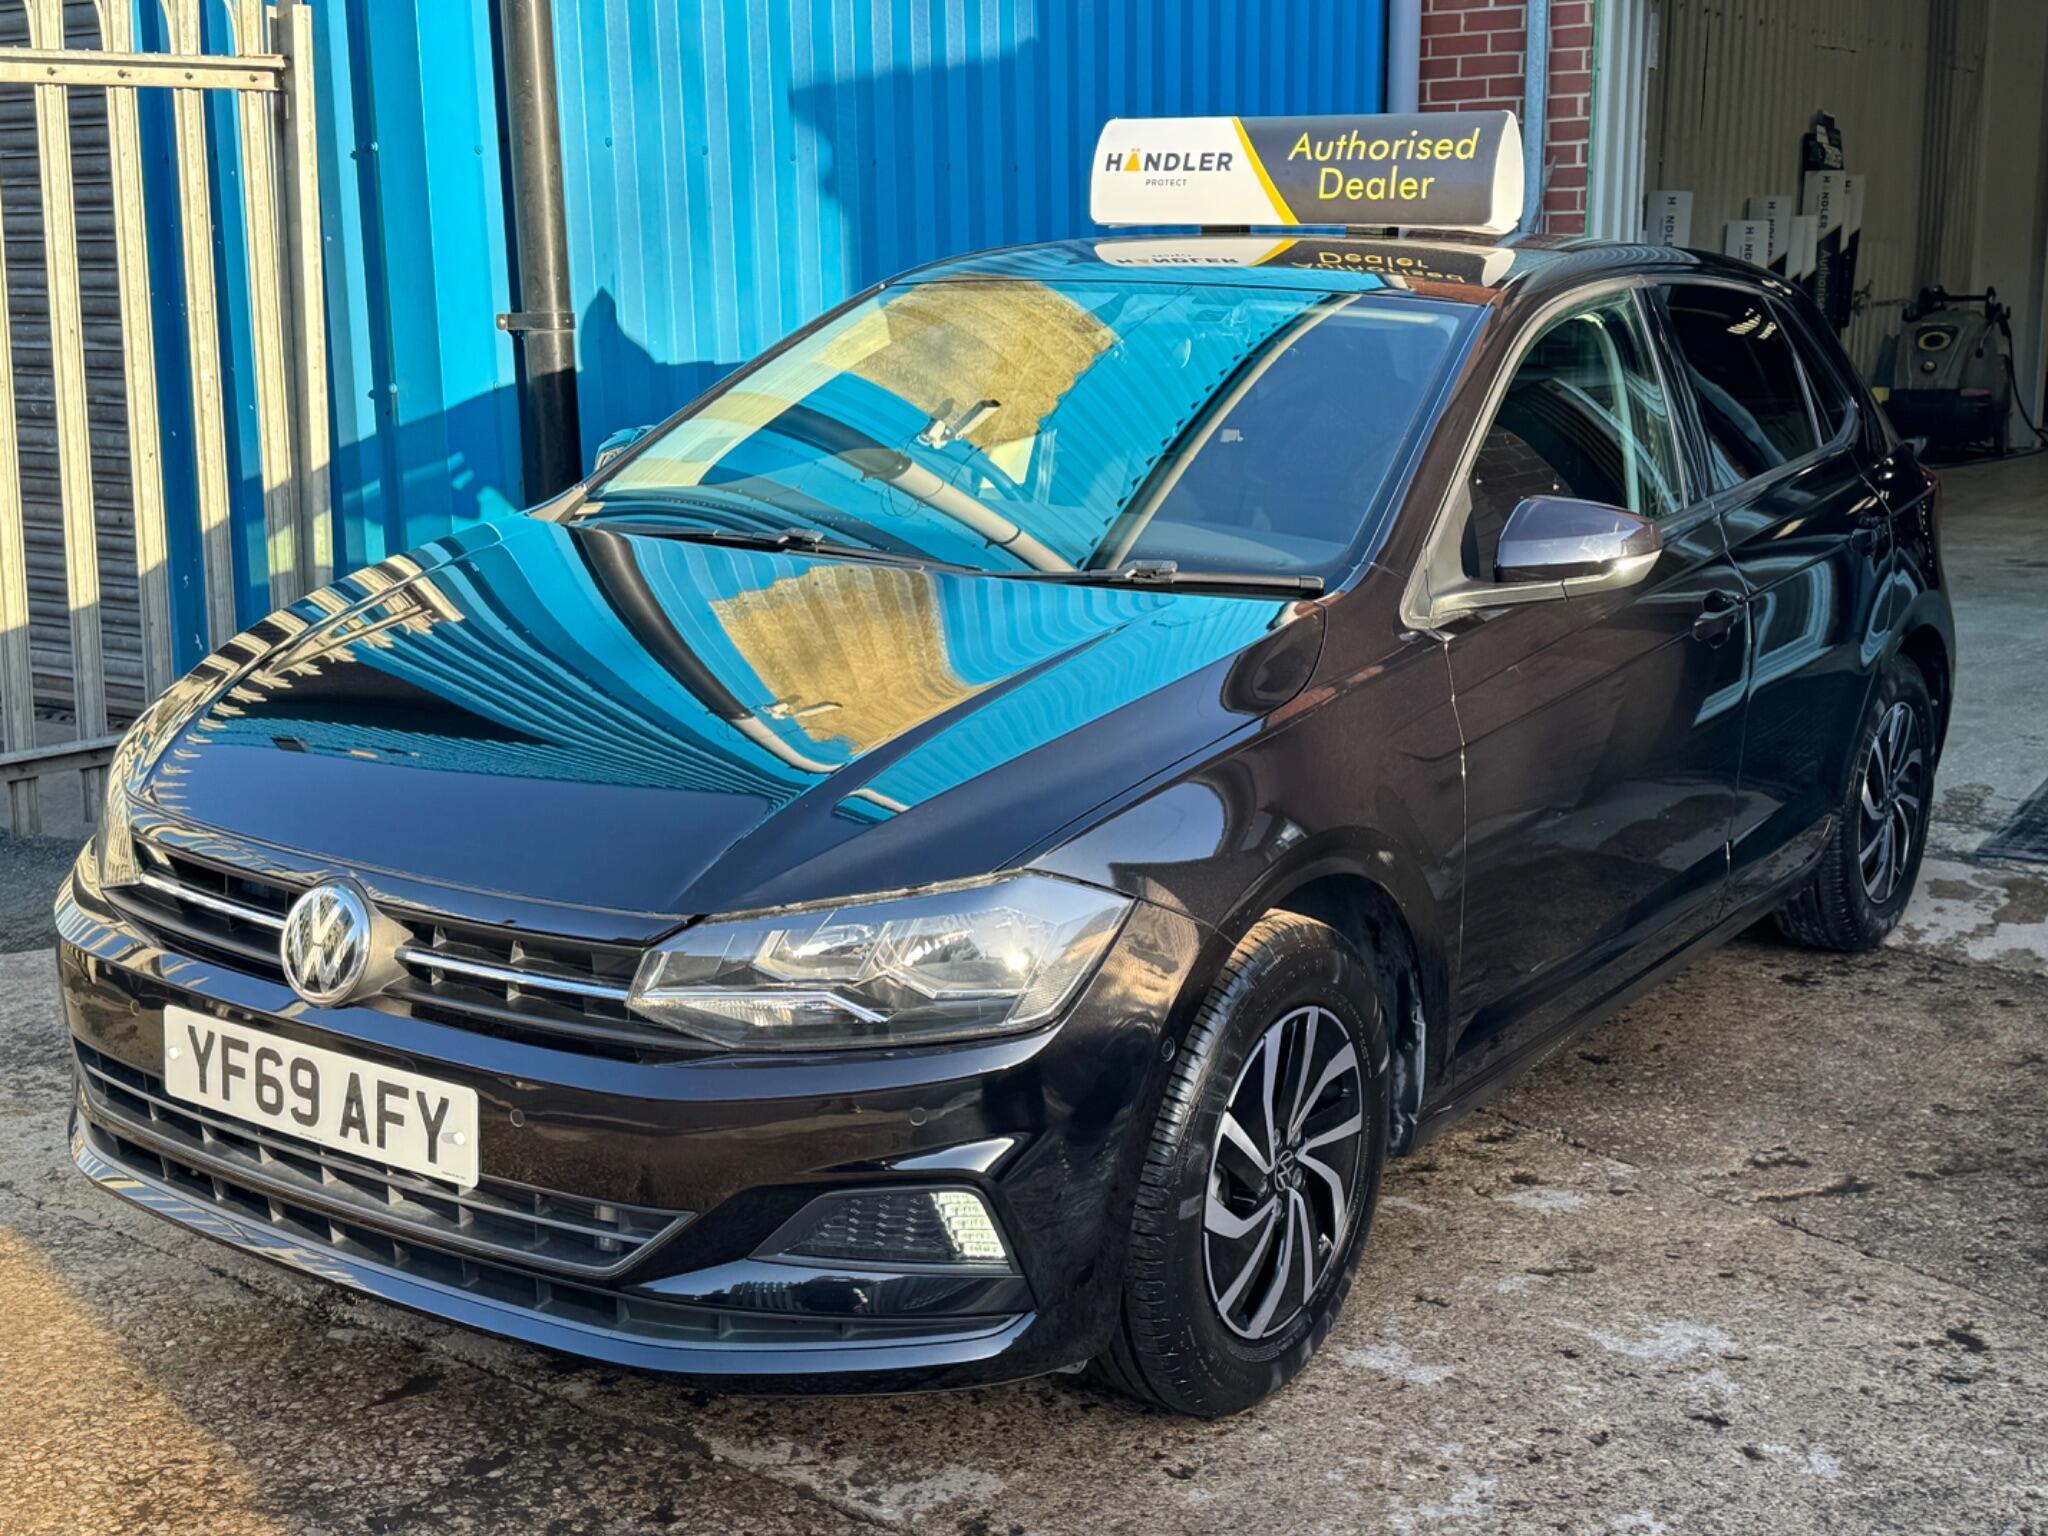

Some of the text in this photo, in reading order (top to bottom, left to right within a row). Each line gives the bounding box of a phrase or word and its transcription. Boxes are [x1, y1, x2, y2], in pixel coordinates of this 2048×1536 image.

[1288, 127, 1480, 161] Authorised
[1145, 178, 1187, 187] PROTECT
[1319, 165, 1435, 200] Dealer
[187, 1024, 450, 1165] YF69 AFY
